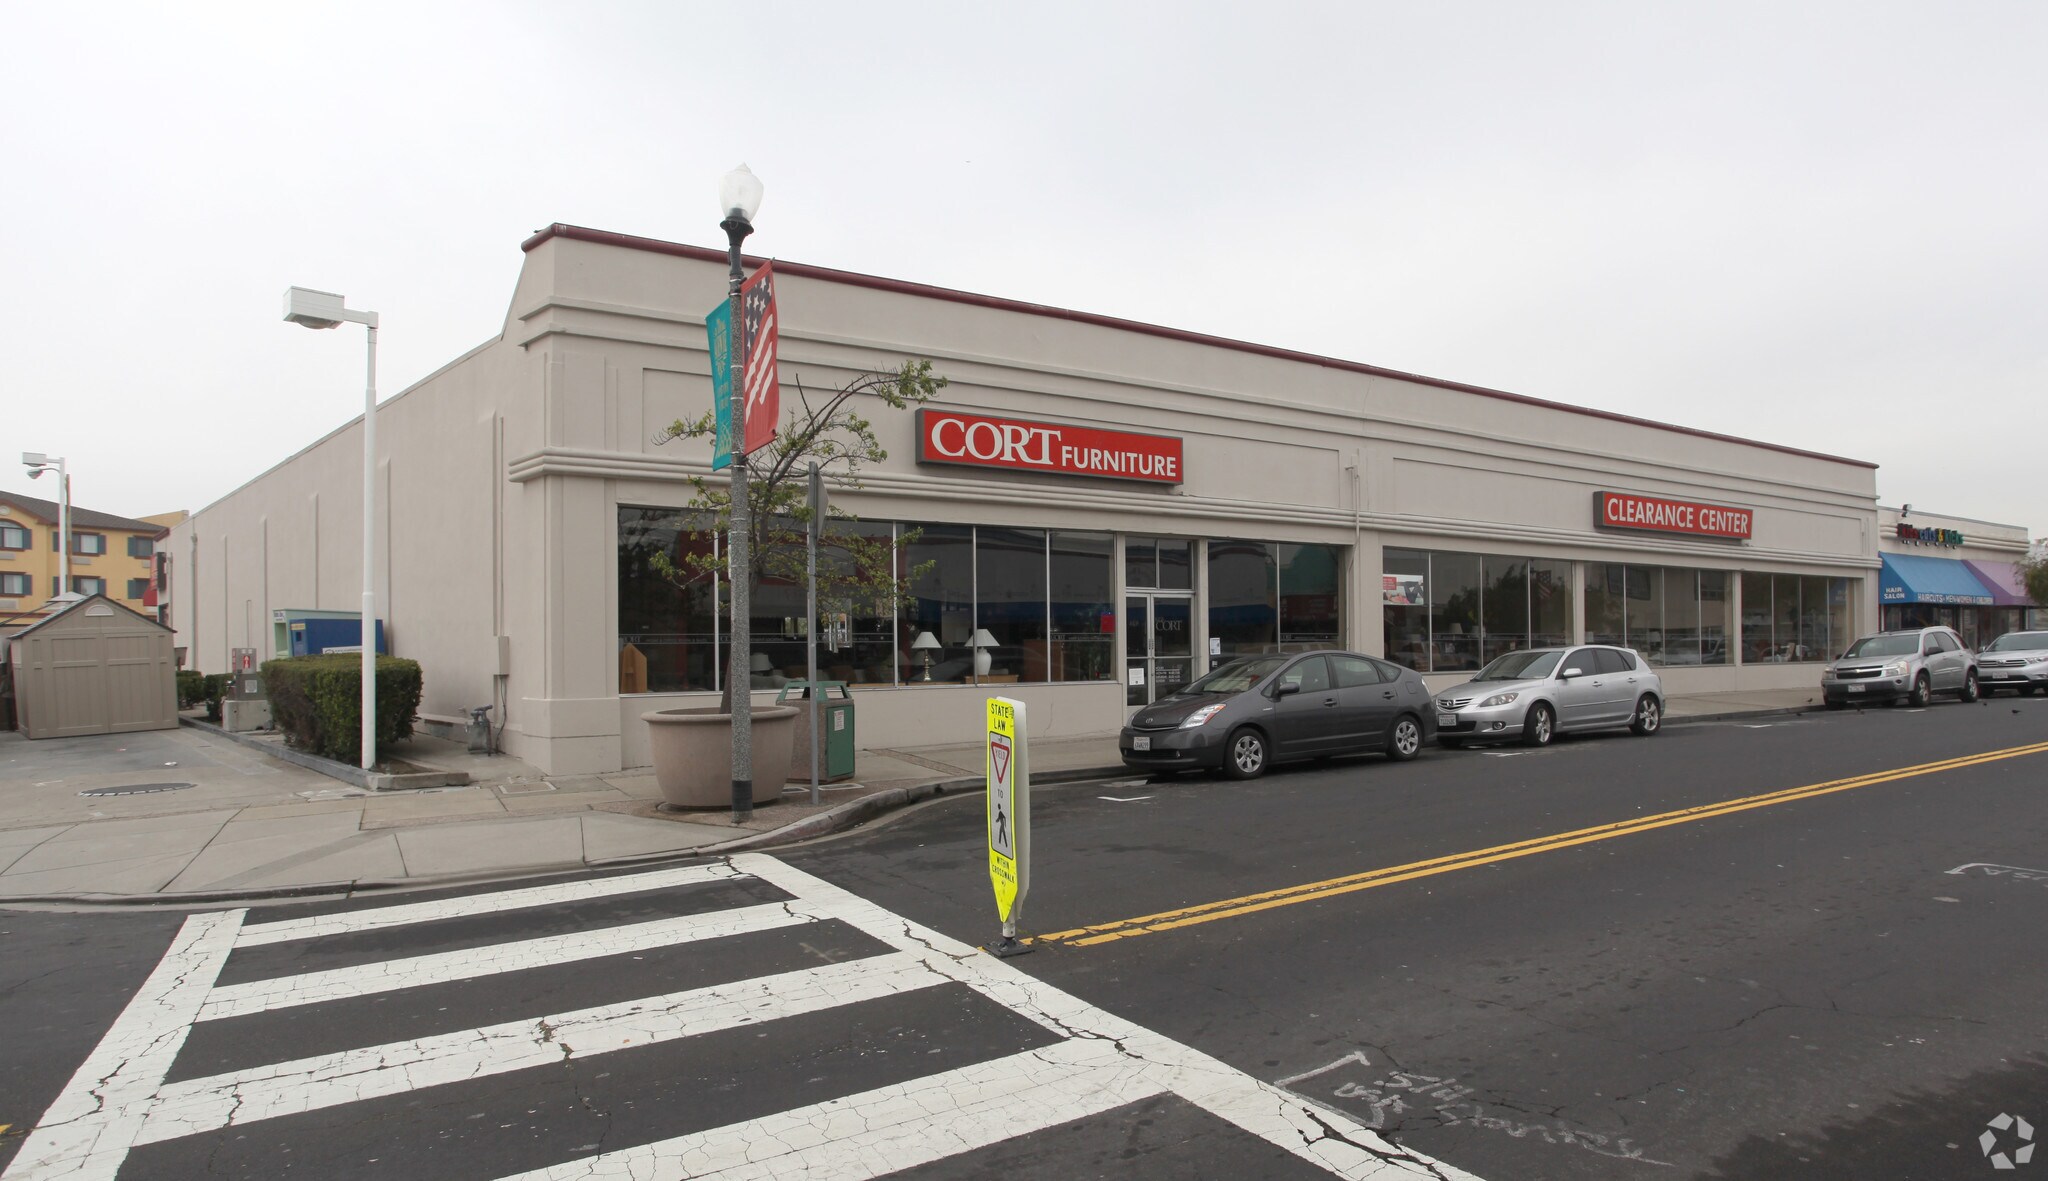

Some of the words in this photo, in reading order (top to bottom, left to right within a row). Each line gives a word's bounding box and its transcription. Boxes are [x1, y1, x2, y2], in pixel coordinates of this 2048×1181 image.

[931, 418, 1062, 465] CORT
[1061, 445, 1176, 477] FURNITURE
[1607, 498, 1694, 528] CLEARANCE
[1699, 508, 1748, 534] CENTER
[1155, 620, 1182, 631] CORT
[991, 703, 1009, 718] STATE
[993, 718, 1006, 731] LAW
[995, 748, 1006, 761] YIELD
[997, 788, 1004, 799] TO
[996, 856, 1009, 869] WITHIN
[992, 864, 1015, 883] CROSSWALK
